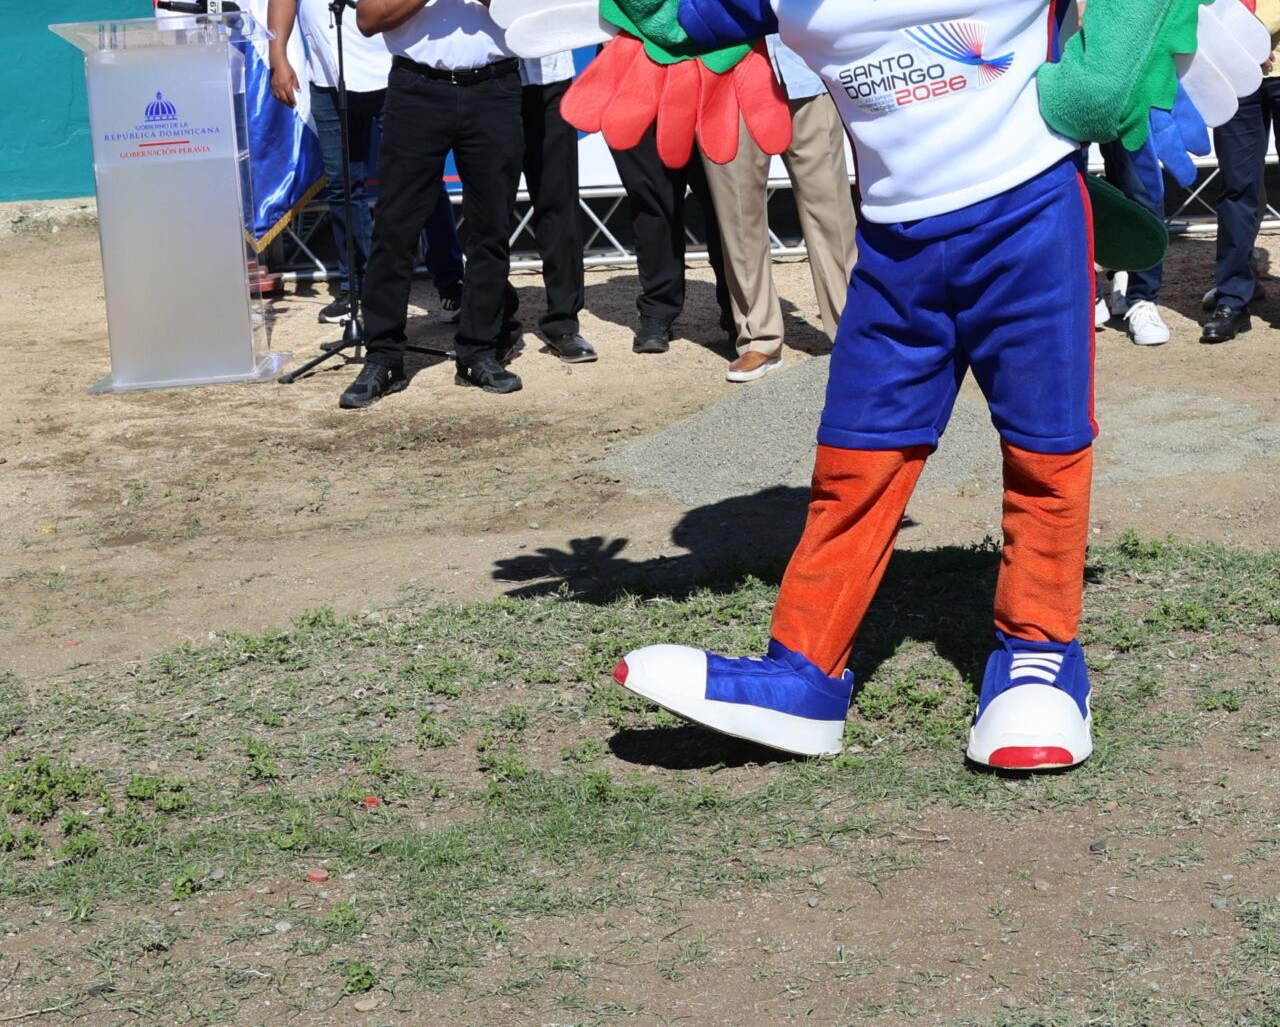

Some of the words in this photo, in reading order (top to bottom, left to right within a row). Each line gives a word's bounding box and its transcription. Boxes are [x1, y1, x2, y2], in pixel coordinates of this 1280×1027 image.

[838, 53, 914, 86] SANTO
[844, 63, 945, 100] DOMINGO
[895, 74, 967, 106] 2026
[104, 131, 156, 141] REPÚBLICA
[159, 127, 220, 137] DOMINICANA
[119, 148, 177, 158] GOBERNACIÓN
